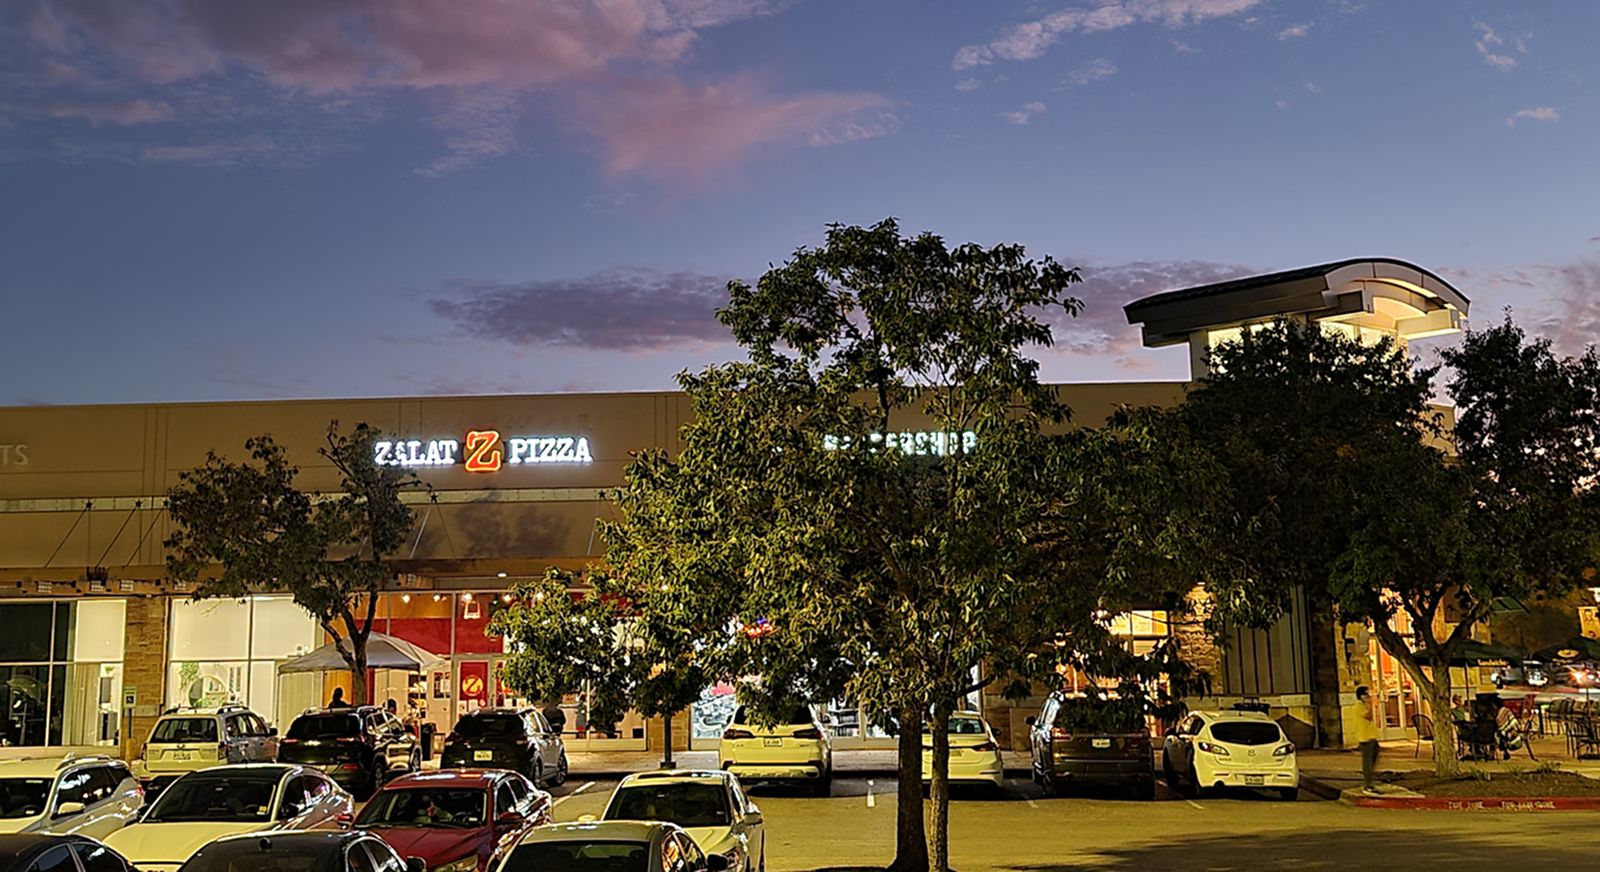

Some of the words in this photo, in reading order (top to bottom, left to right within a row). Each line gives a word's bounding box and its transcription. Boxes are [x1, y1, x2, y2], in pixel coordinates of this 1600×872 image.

[374, 439, 458, 466] ZALAT
[508, 436, 593, 464] PIZZA
[822, 430, 977, 456] ERSHOP
